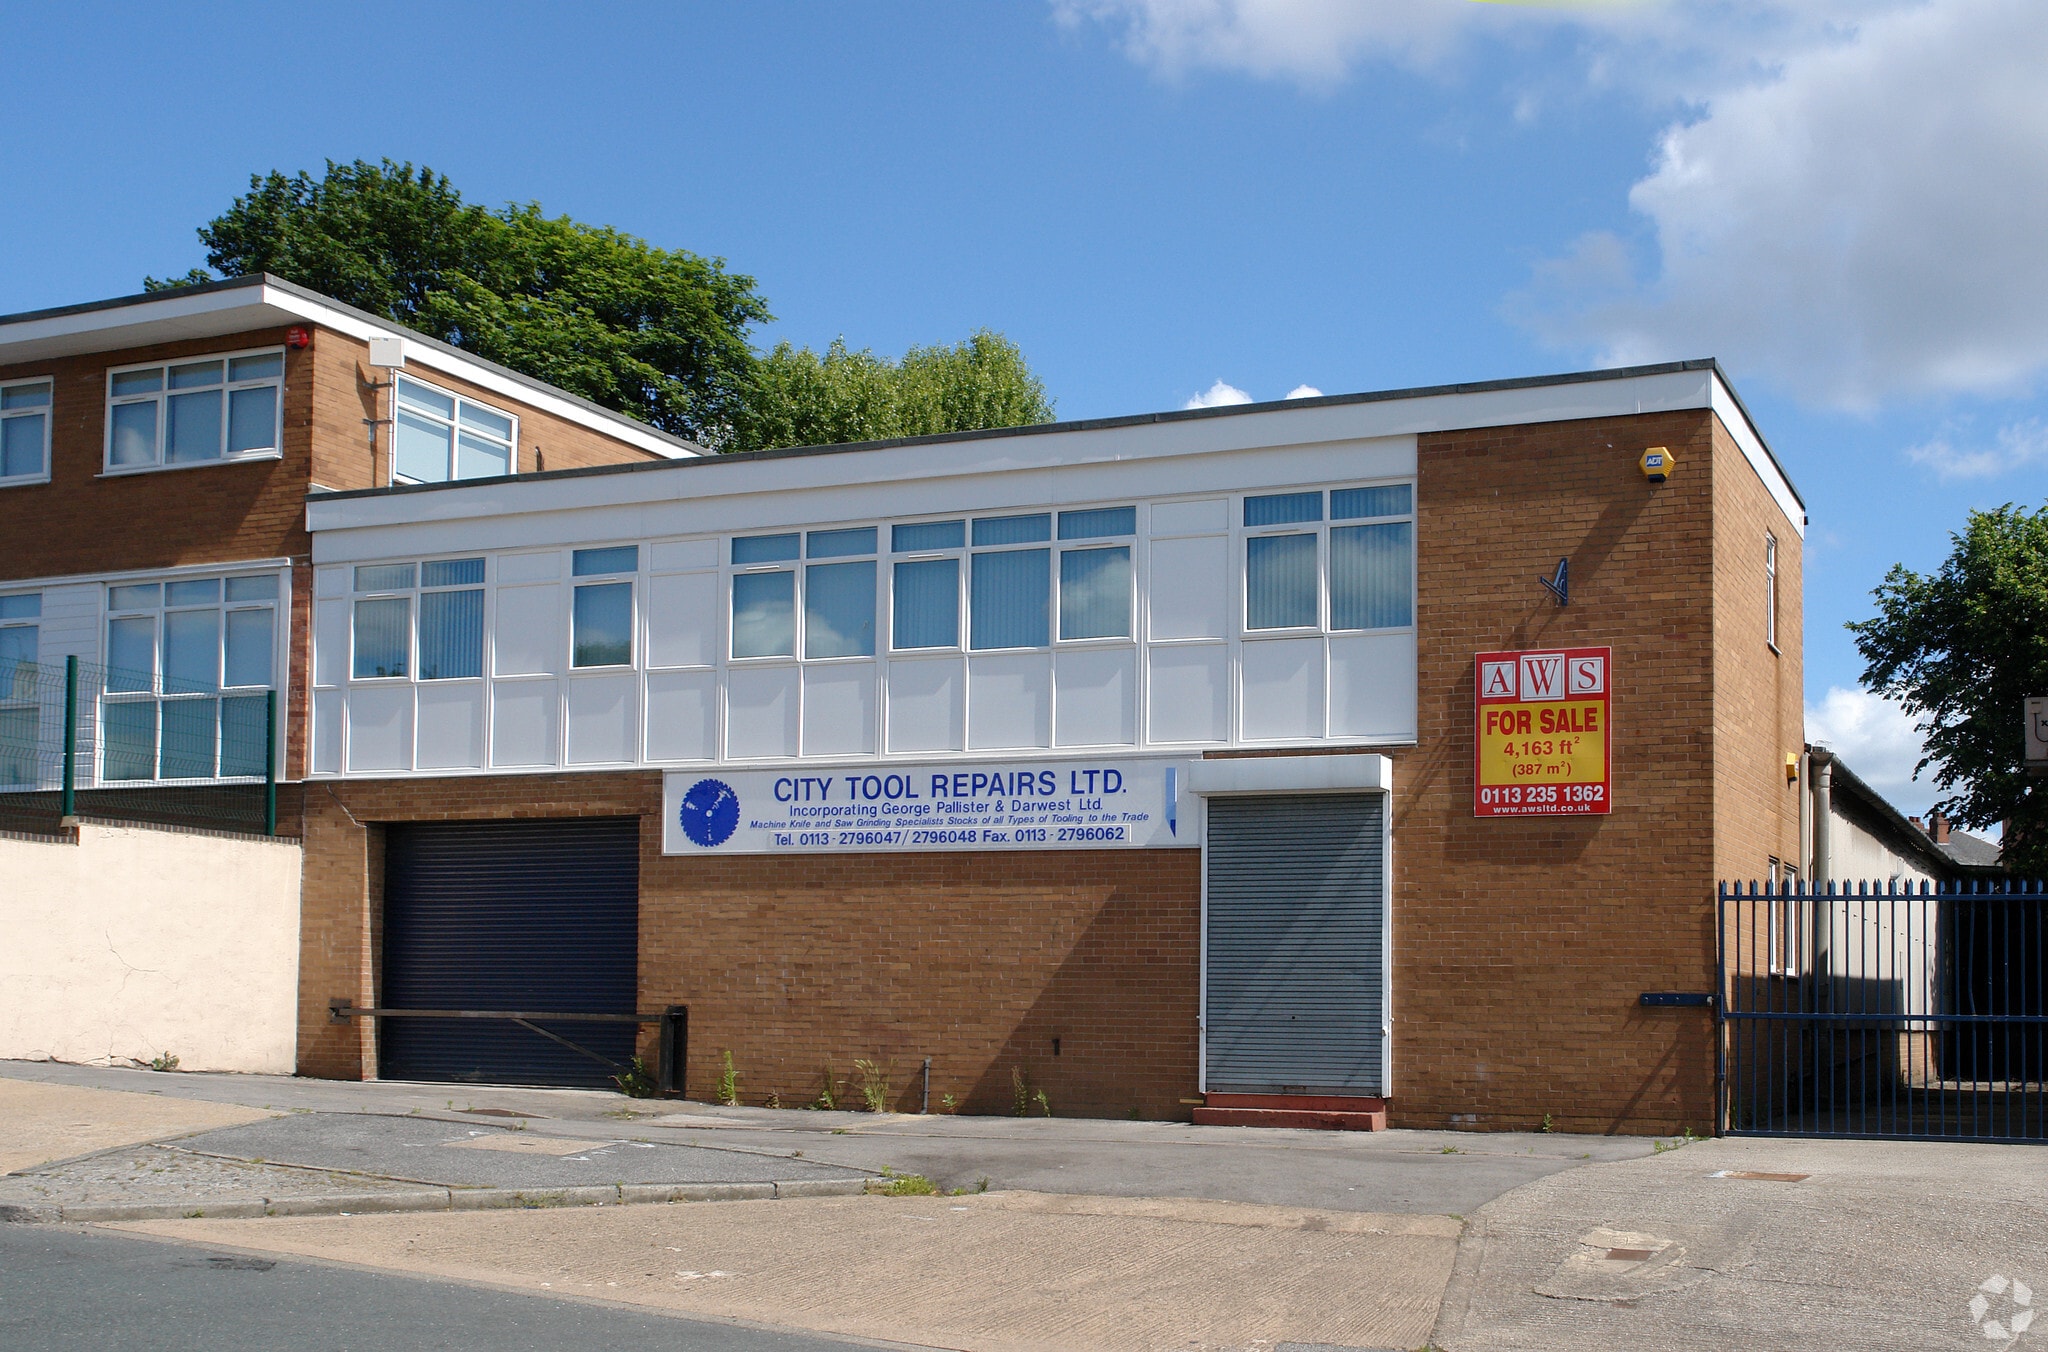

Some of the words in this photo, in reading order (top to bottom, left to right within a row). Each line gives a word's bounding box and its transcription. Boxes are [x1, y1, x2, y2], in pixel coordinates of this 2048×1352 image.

[1646, 457, 1663, 465] ADT
[1486, 658, 1597, 696] AWS
[1486, 710, 1531, 736] FOR
[1540, 707, 1598, 734] SALE
[1504, 741, 1553, 759] 4,163
[1512, 764, 1542, 778] (387
[774, 777, 833, 802] CITY
[845, 774, 919, 800] TOOL
[931, 770, 1056, 798] REPAIRS
[1071, 769, 1127, 796] LTD.
[1481, 787, 1522, 804] 0113
[1526, 786, 1557, 803] 235
[1563, 785, 1604, 802] 1362
[790, 803, 877, 818] Incorporating
[881, 802, 931, 817] George
[936, 801, 990, 814] Pallister
[995, 799, 1005, 813] &
[1012, 799, 1071, 812] Darwest
[1080, 798, 1103, 811] Ltd.
[1493, 803, 1591, 814] www.awsltd.co.uk
[750, 820, 786, 829] Machine
[789, 819, 811, 829] Knife
[815, 819, 832, 828] and
[834, 819, 854, 828] Saw
[856, 818, 891, 829] Grinding
[895, 816, 944, 828] Specialists
[947, 816, 978, 826] Stocks
[982, 815, 992, 824] of
[993, 815, 1005, 824] all
[1008, 815, 1035, 826] Types
[1039, 814, 1048, 824] of
[1052, 813, 1084, 825] Tooling
[1088, 814, 1098, 822] to
[1101, 812, 1120, 822] the
[1122, 812, 1150, 821] Trade
[775, 833, 795, 846] Tel.
[800, 833, 830, 846] 0113
[983, 830, 1011, 843] Fax.
[1015, 829, 1047, 842] 0113
[1057, 827, 1125, 841] 2796062
